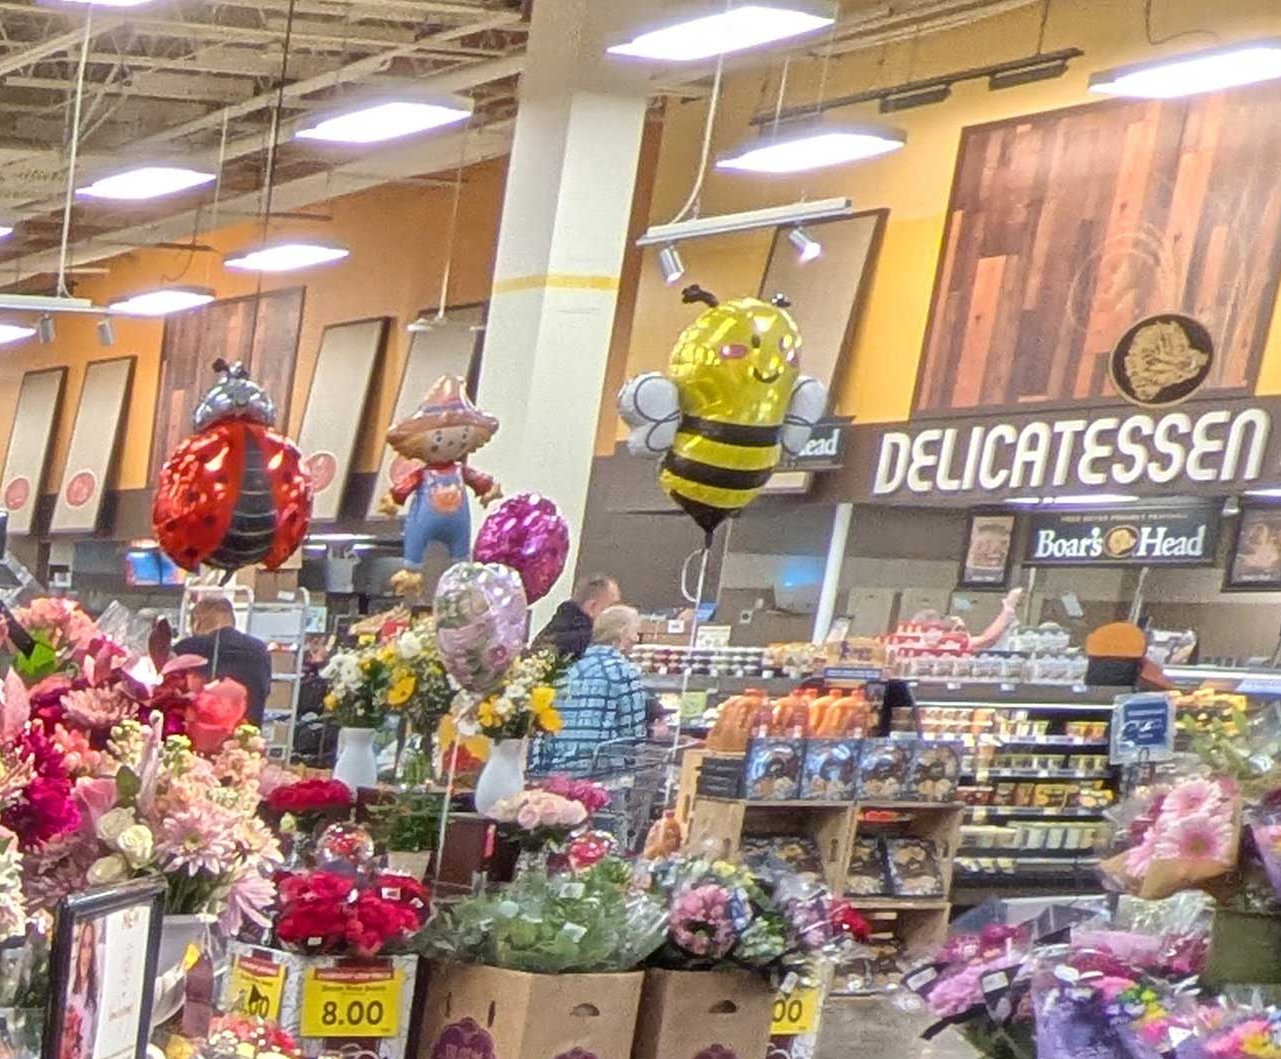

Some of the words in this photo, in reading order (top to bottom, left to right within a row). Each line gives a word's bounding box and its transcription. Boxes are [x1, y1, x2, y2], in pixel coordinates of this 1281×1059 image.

[798, 427, 840, 457] ead
[873, 408, 1271, 494] DELICATESSEN
[1036, 526, 1103, 558] Boar's
[1136, 523, 1207, 557] Head
[321, 1000, 384, 1025] 8.00
